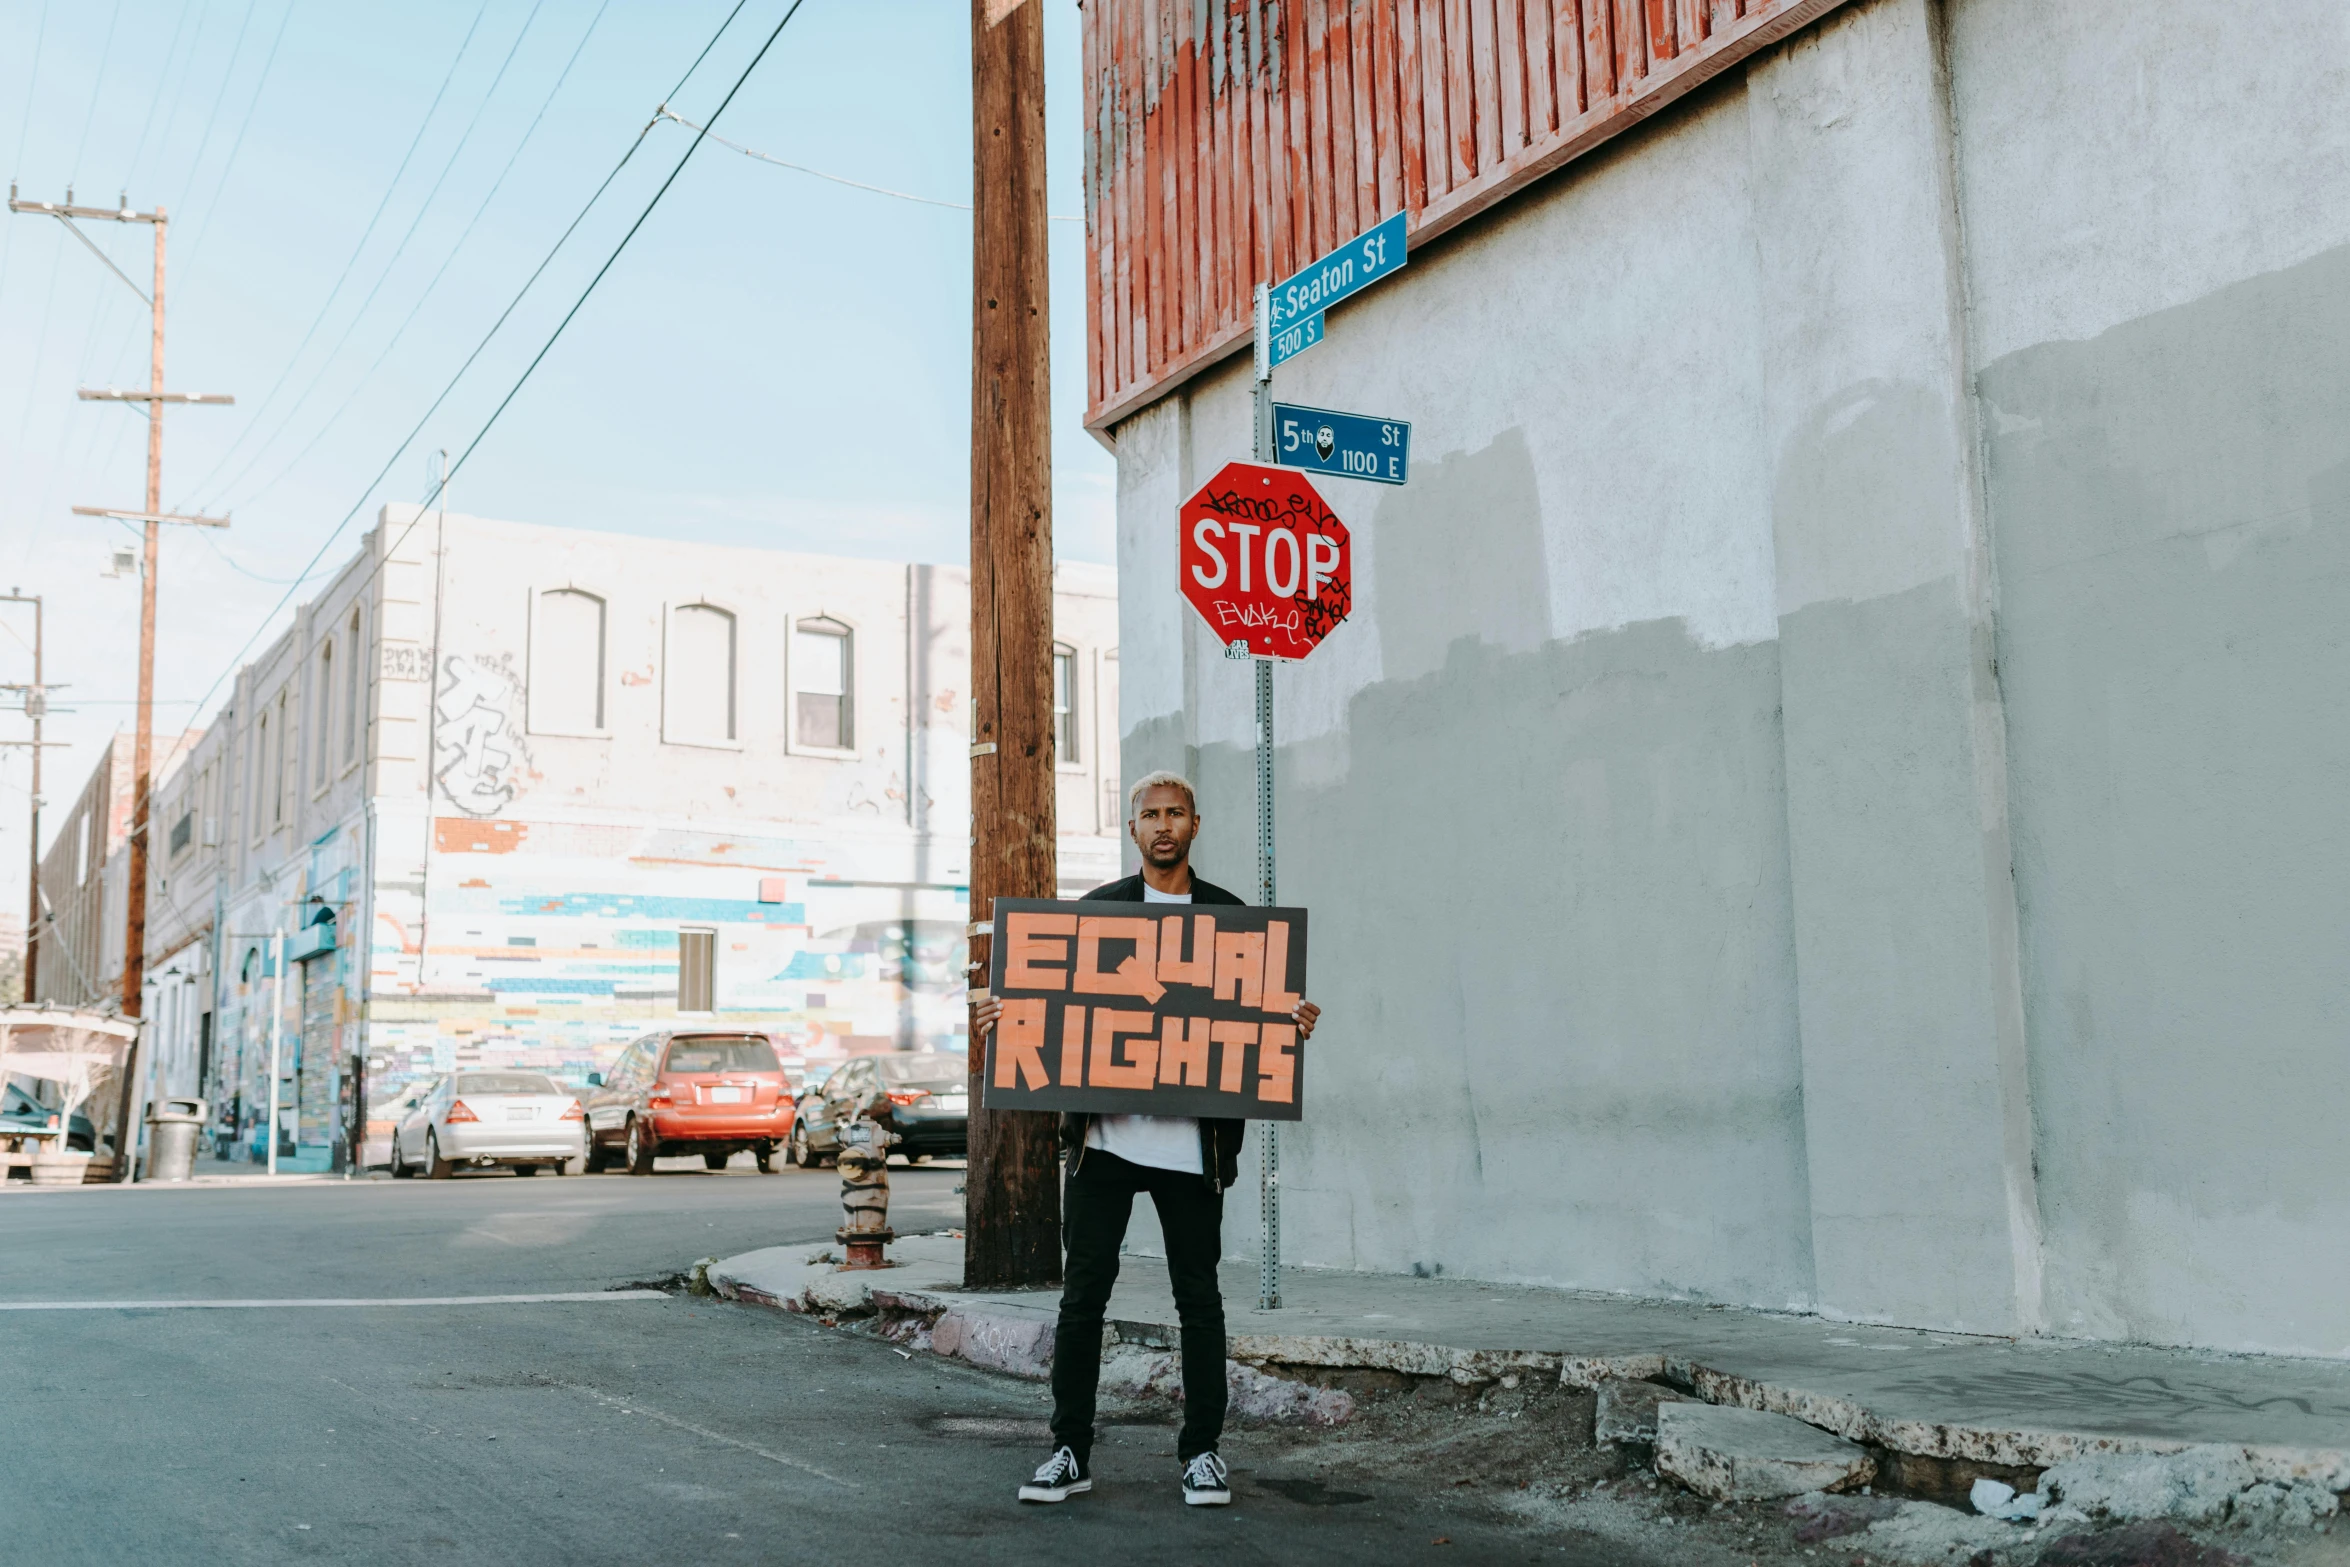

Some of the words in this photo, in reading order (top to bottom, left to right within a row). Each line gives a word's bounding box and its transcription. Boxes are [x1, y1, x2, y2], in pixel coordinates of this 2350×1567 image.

[1286, 259, 1353, 318] Seaton
[1363, 232, 1386, 273] St
[1277, 327, 1301, 360] 500
[1307, 320, 1315, 343] S
[1283, 420, 1314, 452] 5th
[1381, 424, 1400, 447] St
[1342, 449, 1378, 475] 1100
[1389, 456, 1400, 478] E
[1191, 518, 1341, 601] STOP
[1004, 912, 1301, 1014] EQUAL
[994, 998, 1297, 1104] RIGHTS
